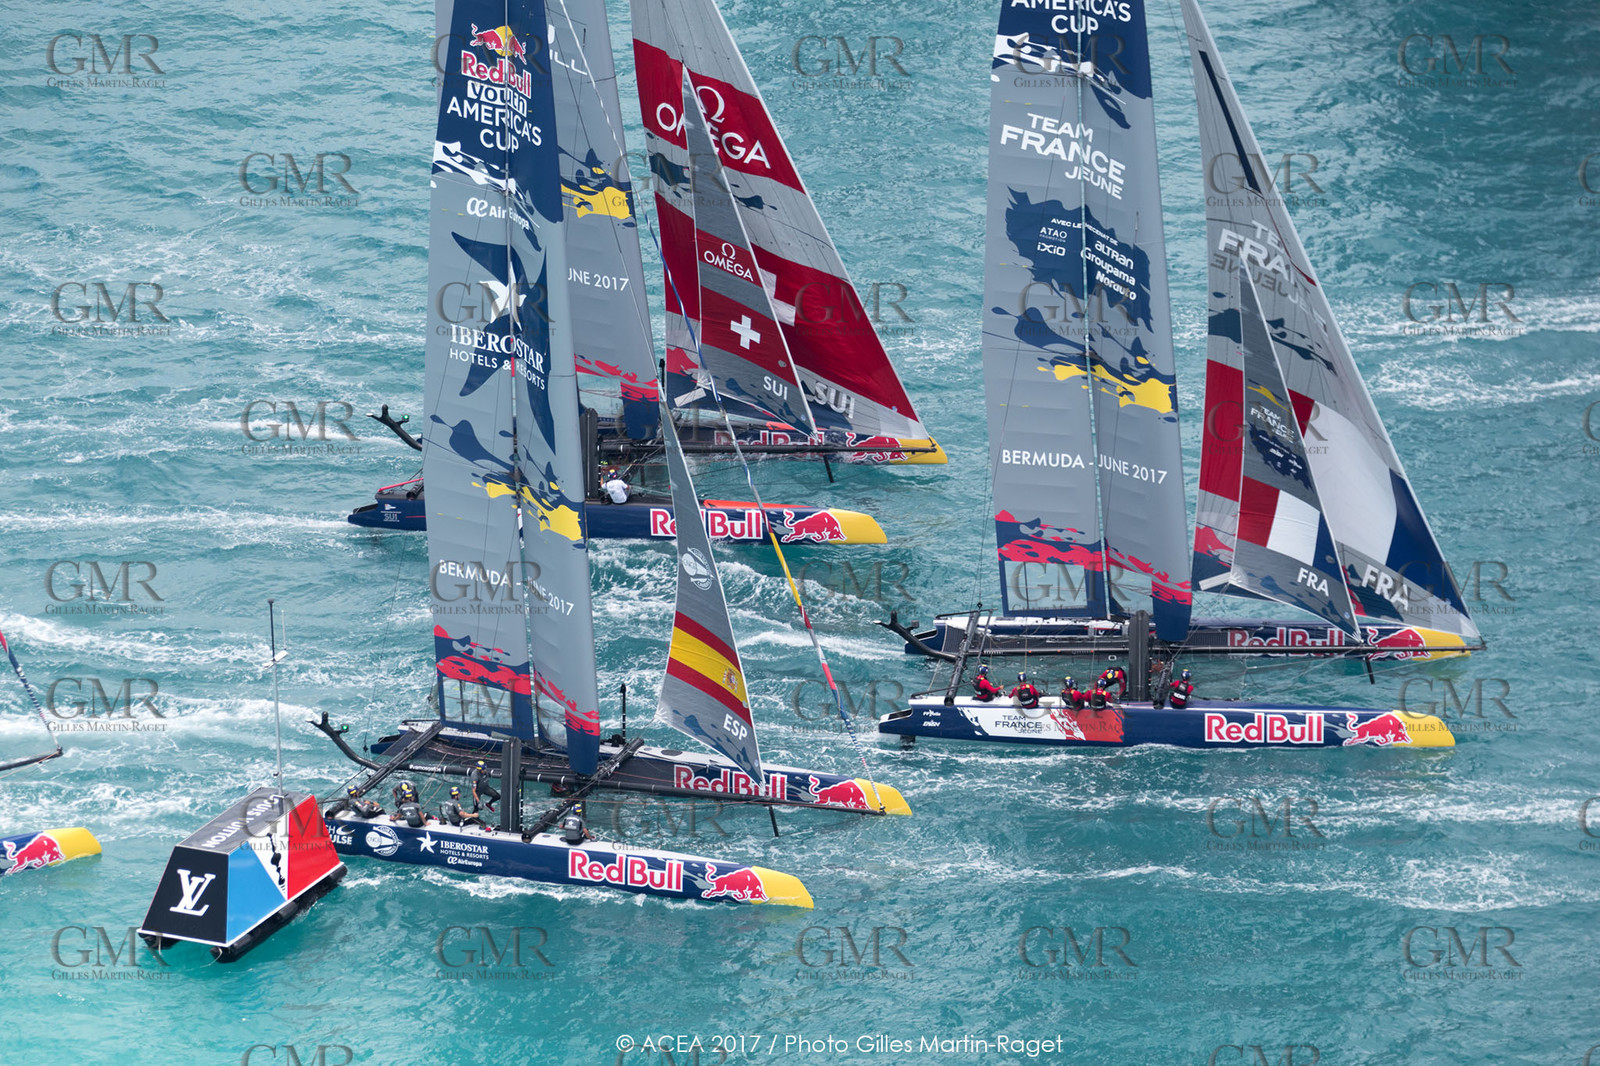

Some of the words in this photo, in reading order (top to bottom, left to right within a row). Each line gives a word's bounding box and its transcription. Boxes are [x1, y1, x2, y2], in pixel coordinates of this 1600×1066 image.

[1051, 14, 1099, 35] CUP
[461, 50, 504, 84] Red
[508, 64, 532, 99] Bull
[447, 97, 542, 147] AMERICA'S
[1027, 112, 1093, 142] TEAM
[479, 129, 519, 153] CUP
[1000, 124, 1126, 185] FRANCE
[1064, 166, 1123, 200] JEUNE
[489, 205, 507, 219] Air
[1051, 218, 1072, 227] AVEC
[1040, 226, 1067, 239] ATAO
[703, 251, 754, 282] OMEGA
[1080, 246, 1136, 286] Groupama
[593, 273, 629, 292] 2017
[1095, 270, 1137, 300] Norauto
[450, 323, 545, 374] IBEROSTAR
[450, 348, 497, 369] HOTELS
[516, 363, 545, 391] RESORTS
[763, 375, 788, 400] SUI
[813, 381, 855, 419] SUI
[1002, 449, 1085, 469] BERMUDA
[1098, 454, 1130, 477] JUNE
[1132, 464, 1168, 485] 2017
[708, 509, 763, 539] Bull
[439, 559, 512, 588] BERMUDA
[549, 592, 575, 616] 2017
[1297, 567, 1329, 597] FRA
[1361, 564, 1409, 611] FRA
[723, 713, 748, 740] ESP
[994, 720, 1042, 728] FRANCE
[1204, 713, 1265, 743] Red
[1267, 713, 1325, 744] Bull
[674, 764, 730, 792] Red
[440, 840, 489, 854] IBEROSTAR
[568, 849, 626, 885] Red
[627, 856, 684, 892] Bull
